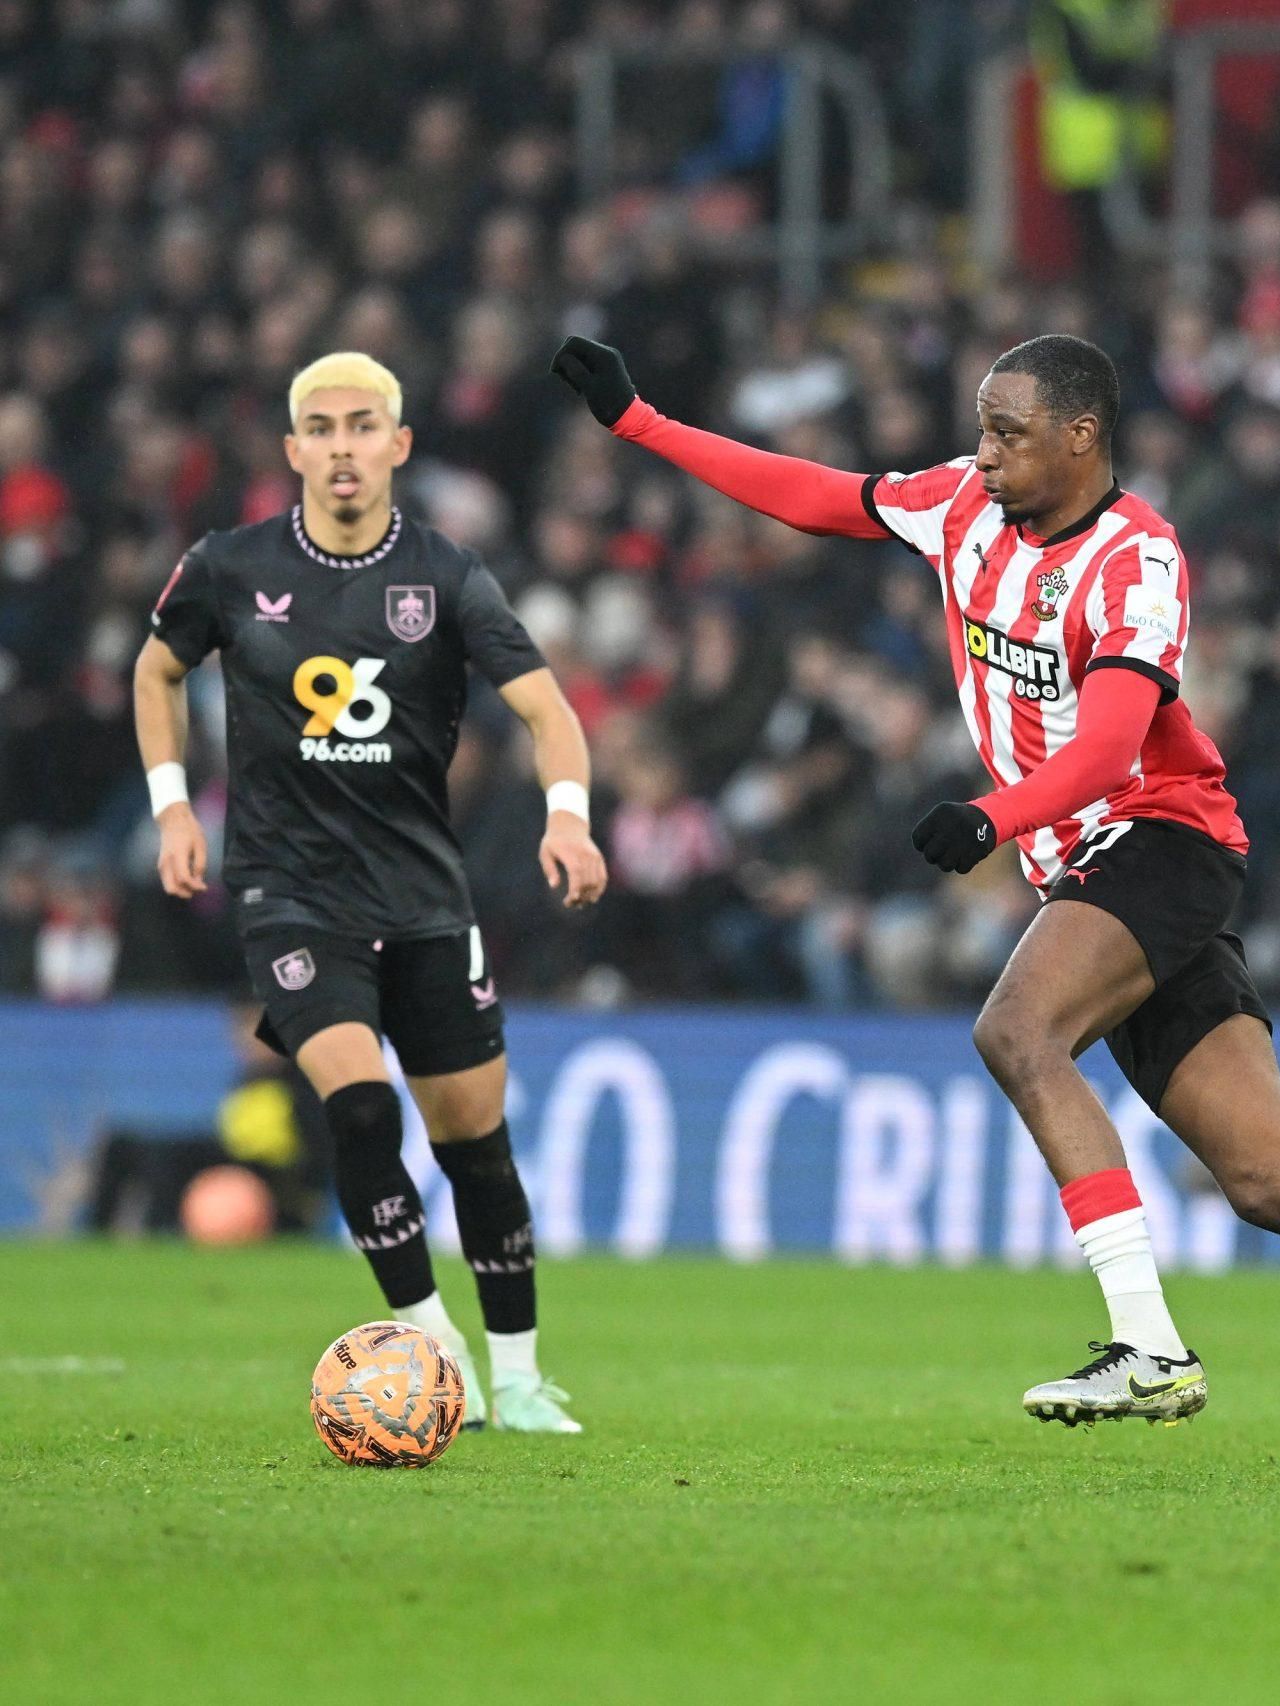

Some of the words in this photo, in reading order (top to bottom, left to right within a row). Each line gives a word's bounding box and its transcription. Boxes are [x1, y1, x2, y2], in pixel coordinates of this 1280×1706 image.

[966, 621, 1055, 681] OLLBIT
[293, 655, 391, 738] 96
[300, 738, 391, 763] 96.com
